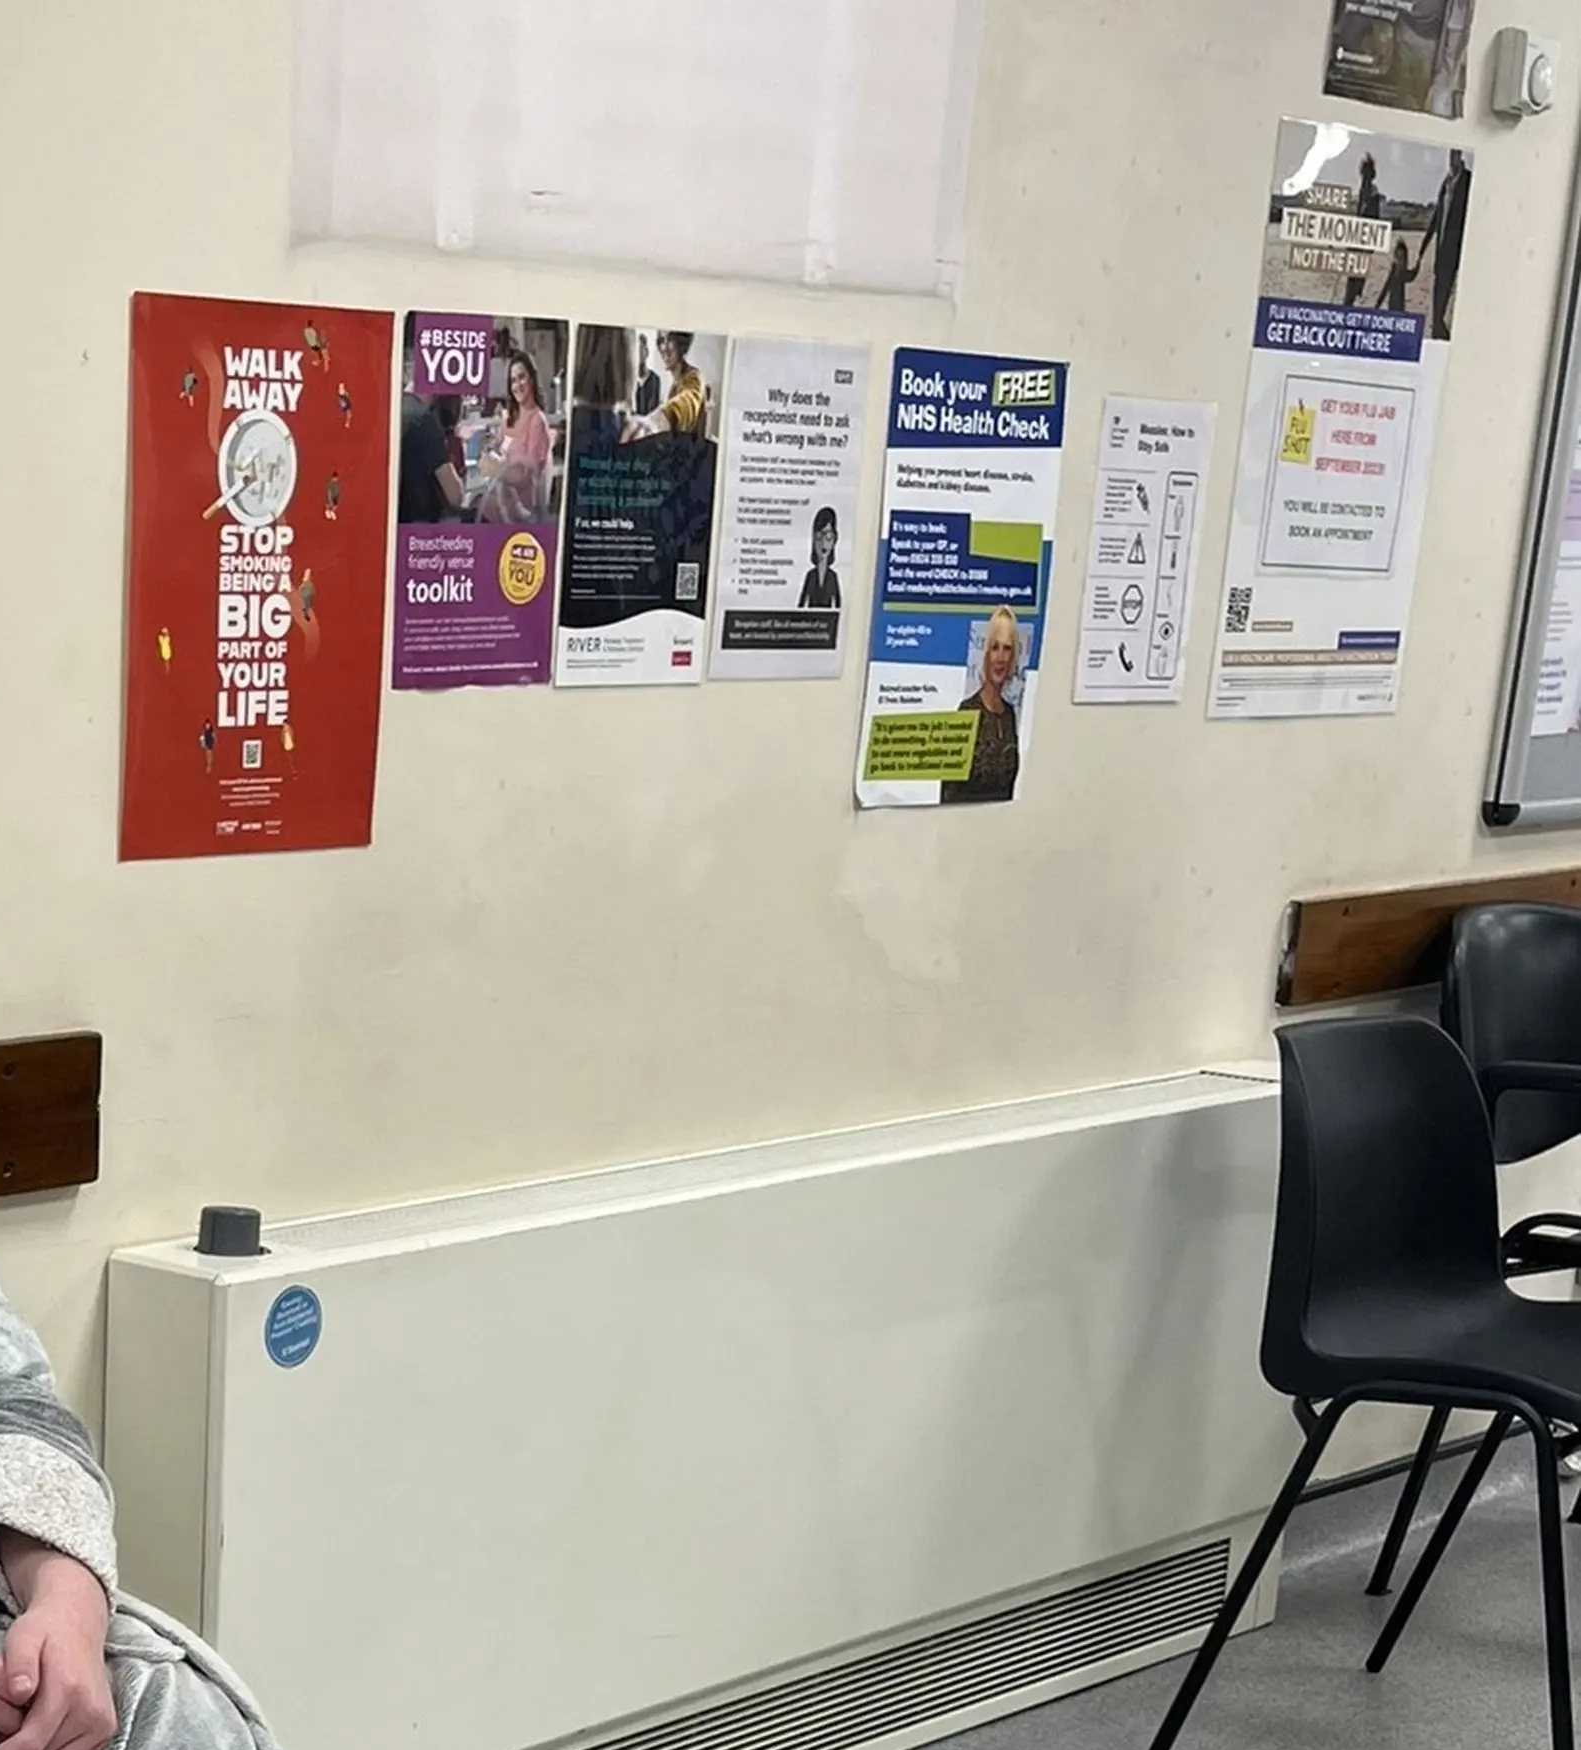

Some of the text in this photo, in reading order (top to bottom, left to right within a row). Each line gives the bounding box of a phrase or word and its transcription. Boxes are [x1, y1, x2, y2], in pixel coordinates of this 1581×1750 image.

[1307, 186, 1348, 209] SHARE
[1287, 212, 1388, 247] THE MOMENT
[1292, 248, 1369, 275] NOT THE FLU
[1270, 305, 1286, 319] FLU
[1346, 313, 1361, 327] GET
[1363, 314, 1371, 327] IT
[1372, 315, 1394, 330] DONE
[1396, 318, 1416, 332] HERE
[420, 329, 487, 349] #BESIDE
[1267, 323, 1391, 352] GET BACK OUT THERE
[224, 346, 303, 380] WALK
[421, 348, 484, 385] YOU
[223, 379, 303, 412] AWAY
[900, 368, 1051, 405] Book your FREE
[768, 389, 831, 406] Why does the
[743, 411, 850, 428] receptionist need to ask
[1320, 399, 1396, 420] GET YOUR FLU JAB
[897, 403, 1050, 440] NHS Health Check
[1291, 416, 1307, 435] FLU
[775, 434, 805, 450] wrong
[807, 434, 827, 447] with
[829, 434, 848, 447] me?
[1283, 435, 1311, 454] SHOT
[1331, 430, 1378, 446] HERE FROM
[1315, 457, 1361, 473] SEPTEMBER
[1284, 500, 1385, 518] YOU WILL BE CONTACTED TO
[220, 524, 294, 554] STOP
[1288, 525, 1374, 541] BOOK AN APPOINTMENT
[408, 535, 474, 554] Breastfeeding
[220, 556, 292, 572] SMOKING
[407, 555, 475, 572] friendly venue
[219, 572, 292, 592] BEING A
[406, 575, 474, 603] toolkit
[218, 594, 292, 638] BIG
[218, 641, 287, 659] PART OF
[567, 637, 601, 652] RIVER
[217, 662, 286, 688] YOUR
[218, 690, 289, 727] LIFE
